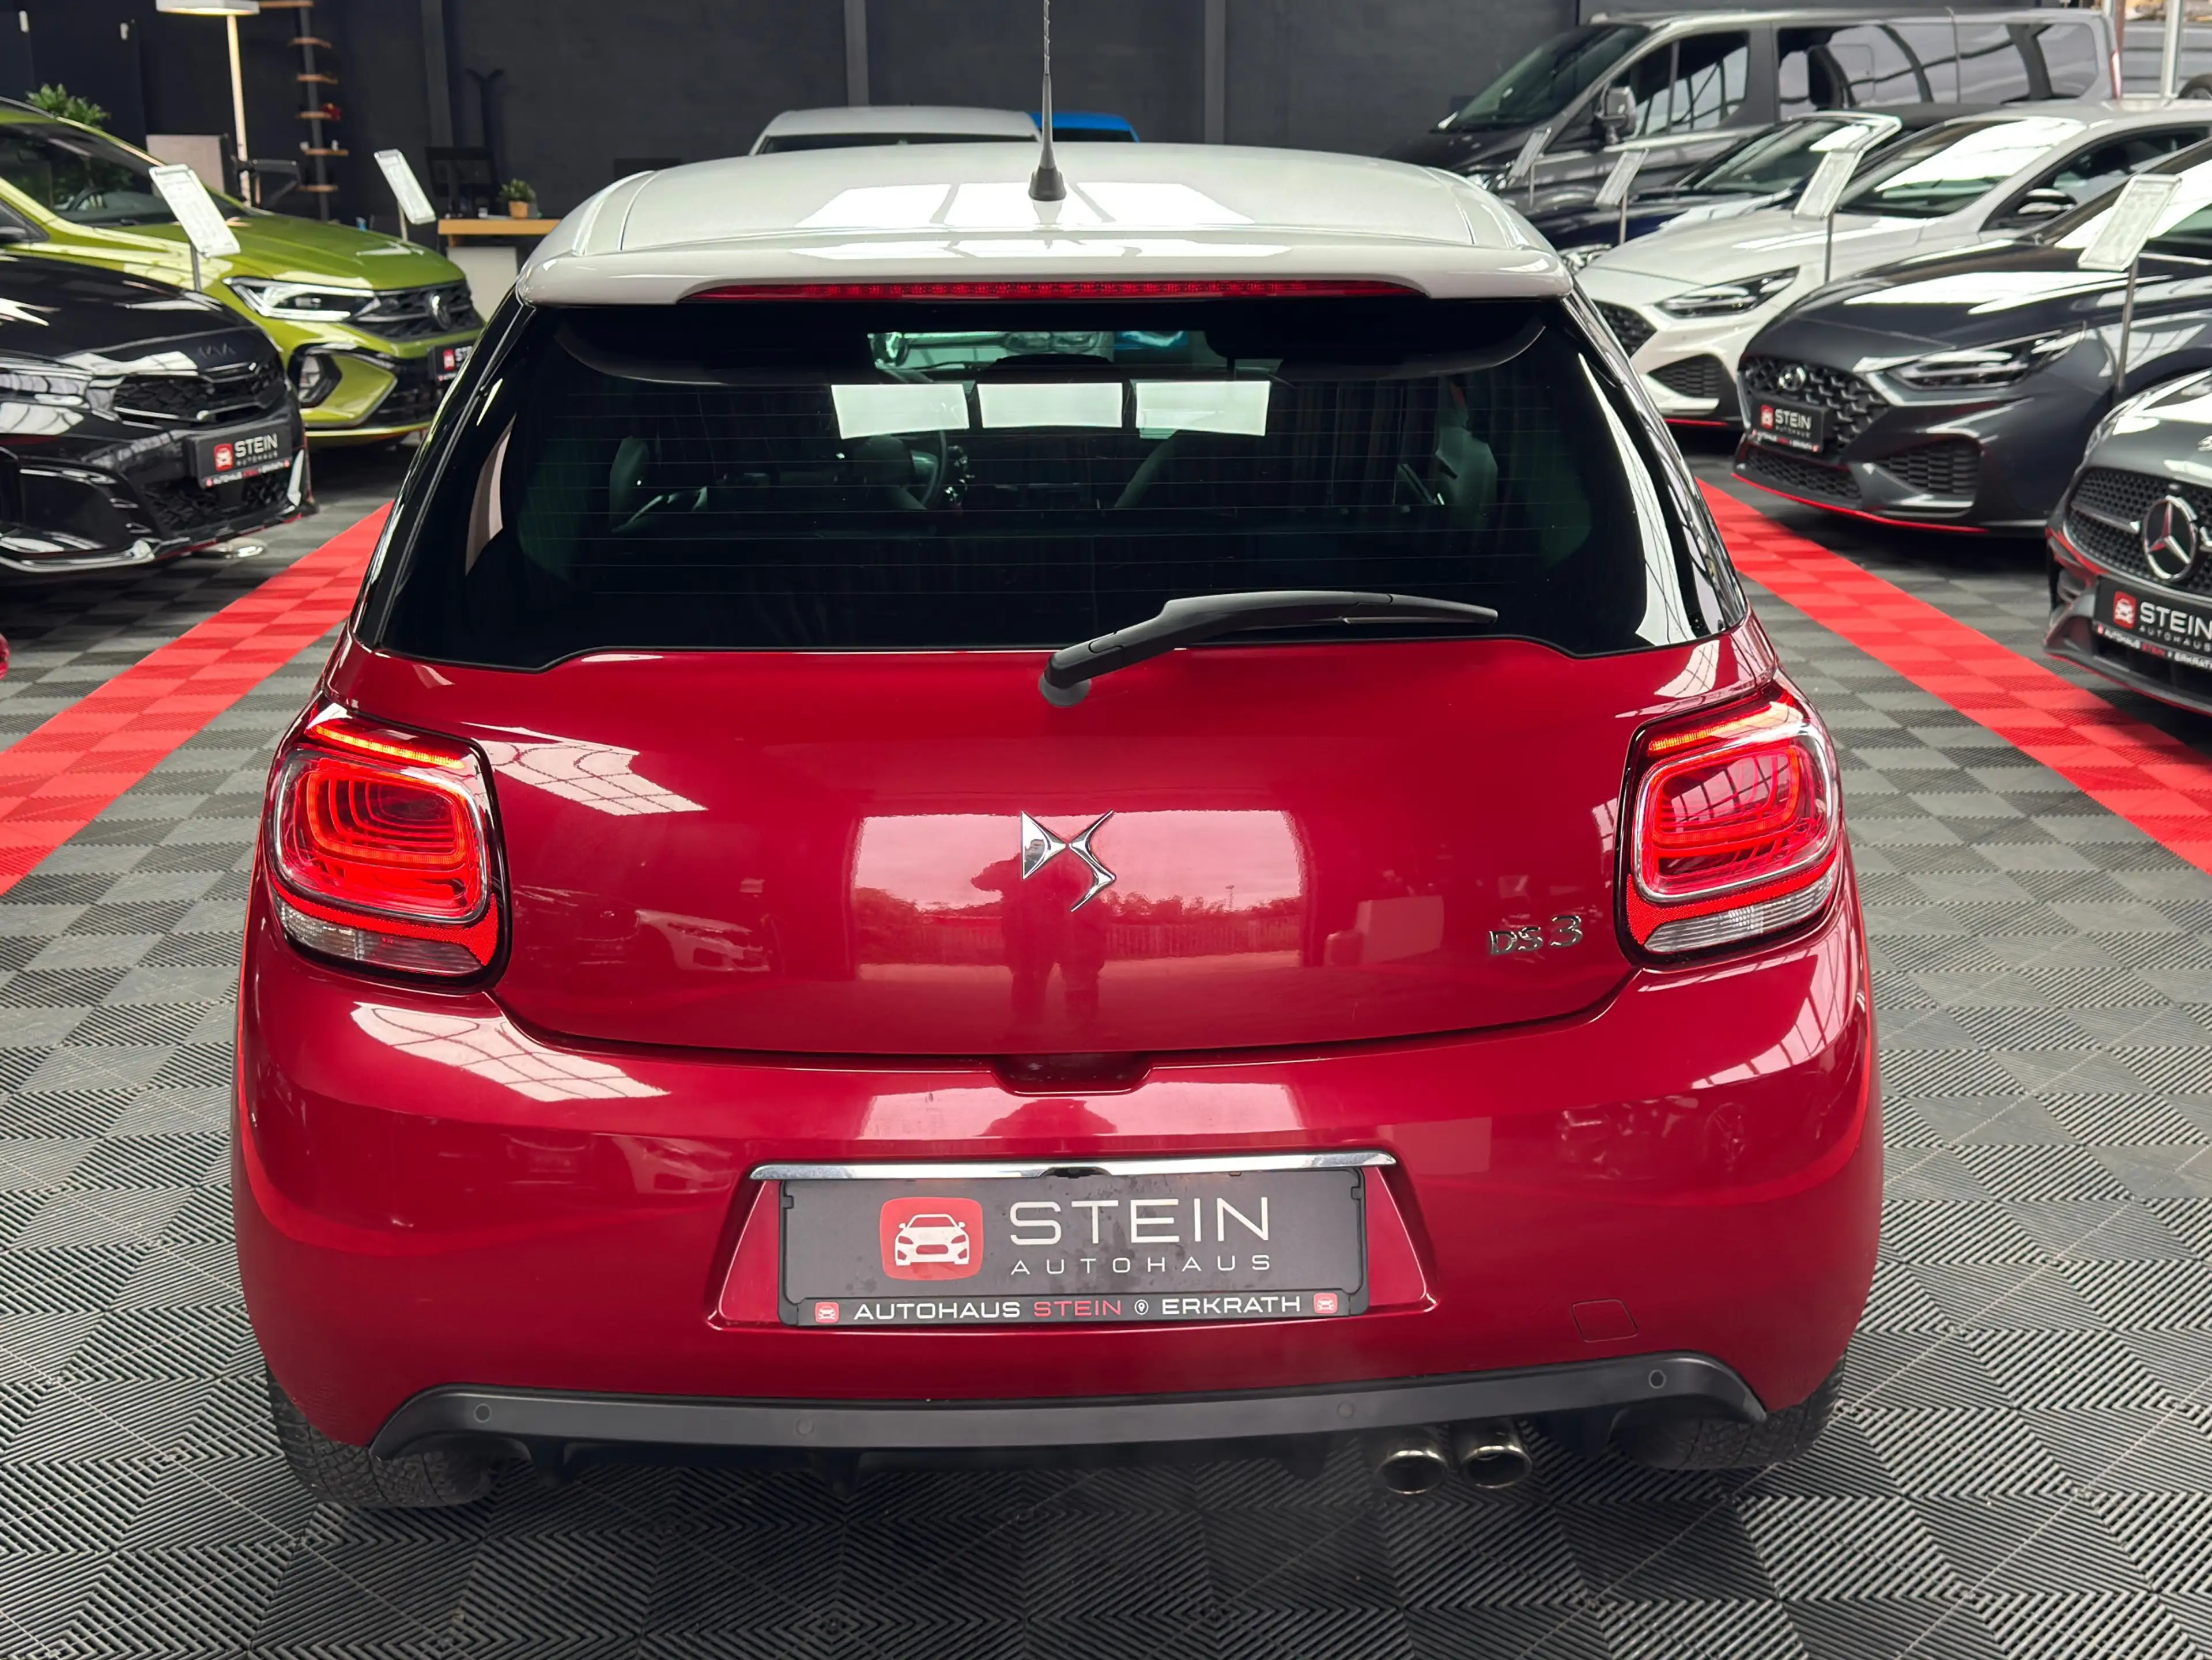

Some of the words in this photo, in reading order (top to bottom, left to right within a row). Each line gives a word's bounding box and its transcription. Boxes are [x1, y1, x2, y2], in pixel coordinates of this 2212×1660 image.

[1775, 409, 1812, 431] STEIN
[235, 433, 278, 458] STEIN
[2140, 601, 2212, 640] STEIN
[2139, 625, 2211, 652] AUTOHAUS
[1489, 927, 1543, 955] DS
[1549, 915, 1583, 947] 3
[1009, 1197, 1270, 1246] STEIN
[1010, 1254, 1270, 1276] AUTOHAUS
[854, 1301, 1021, 1320] AUTOHAUS
[1033, 1300, 1122, 1318] STEIN
[1162, 1296, 1301, 1315] ERKRATH
